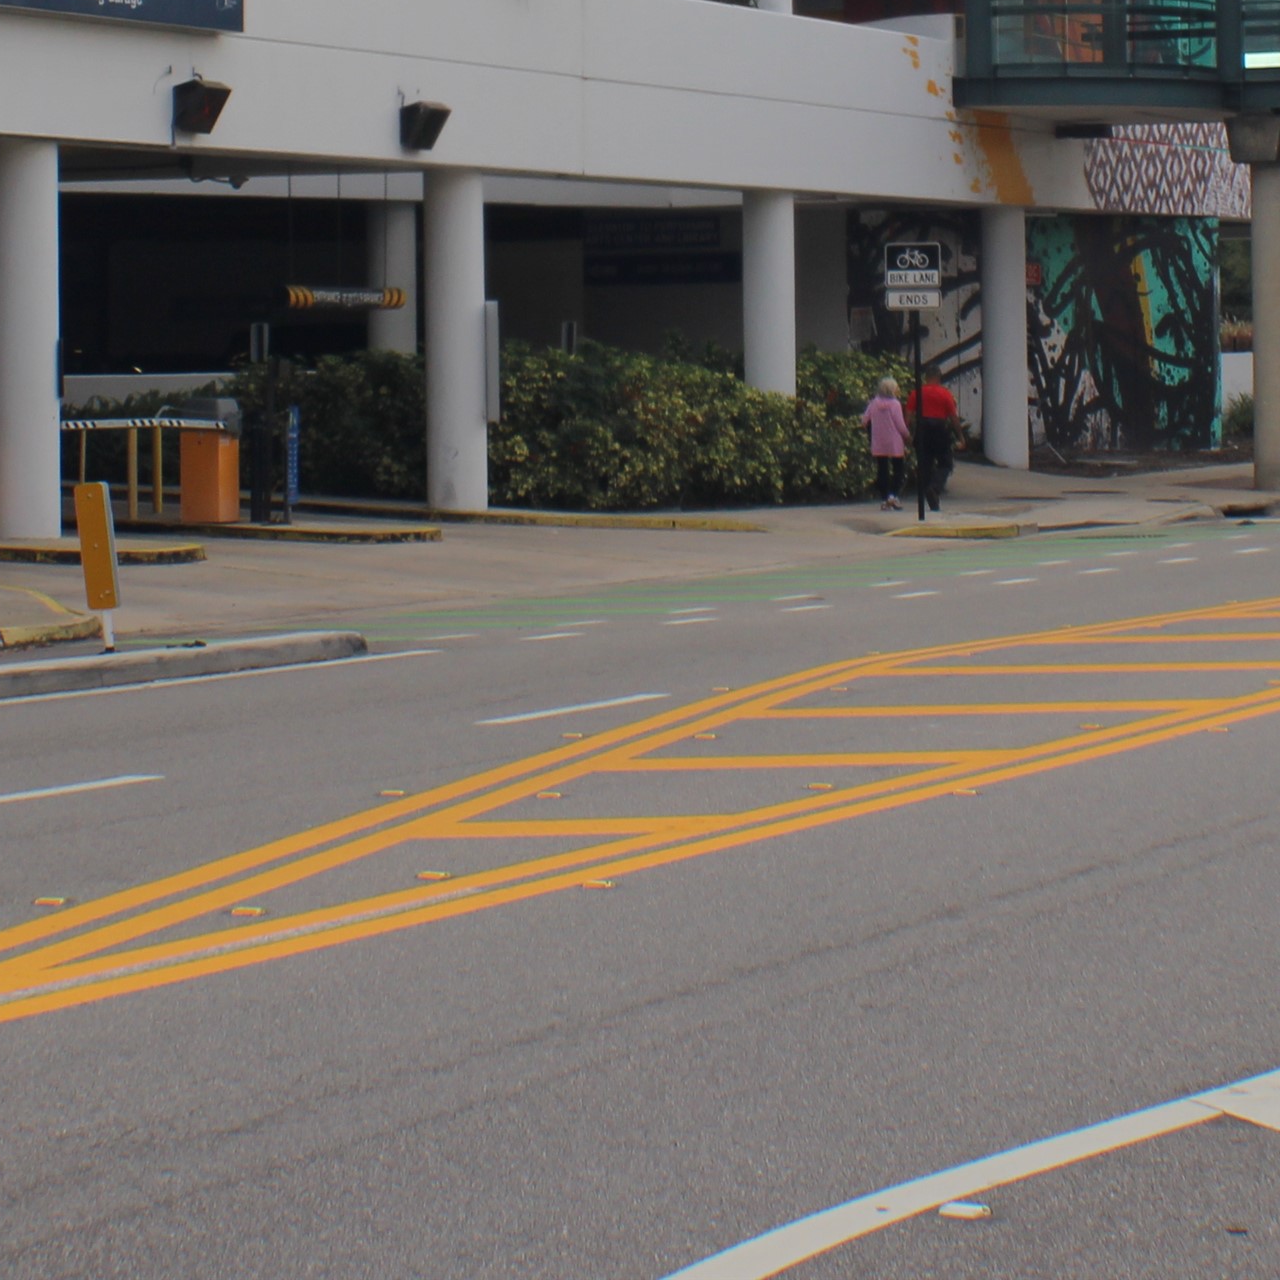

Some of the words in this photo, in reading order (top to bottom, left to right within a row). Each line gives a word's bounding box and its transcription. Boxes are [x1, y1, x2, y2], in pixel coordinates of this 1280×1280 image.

[890, 273, 909, 283] BIKE
[913, 273, 936, 283] LANE
[899, 294, 928, 305] ENDS
